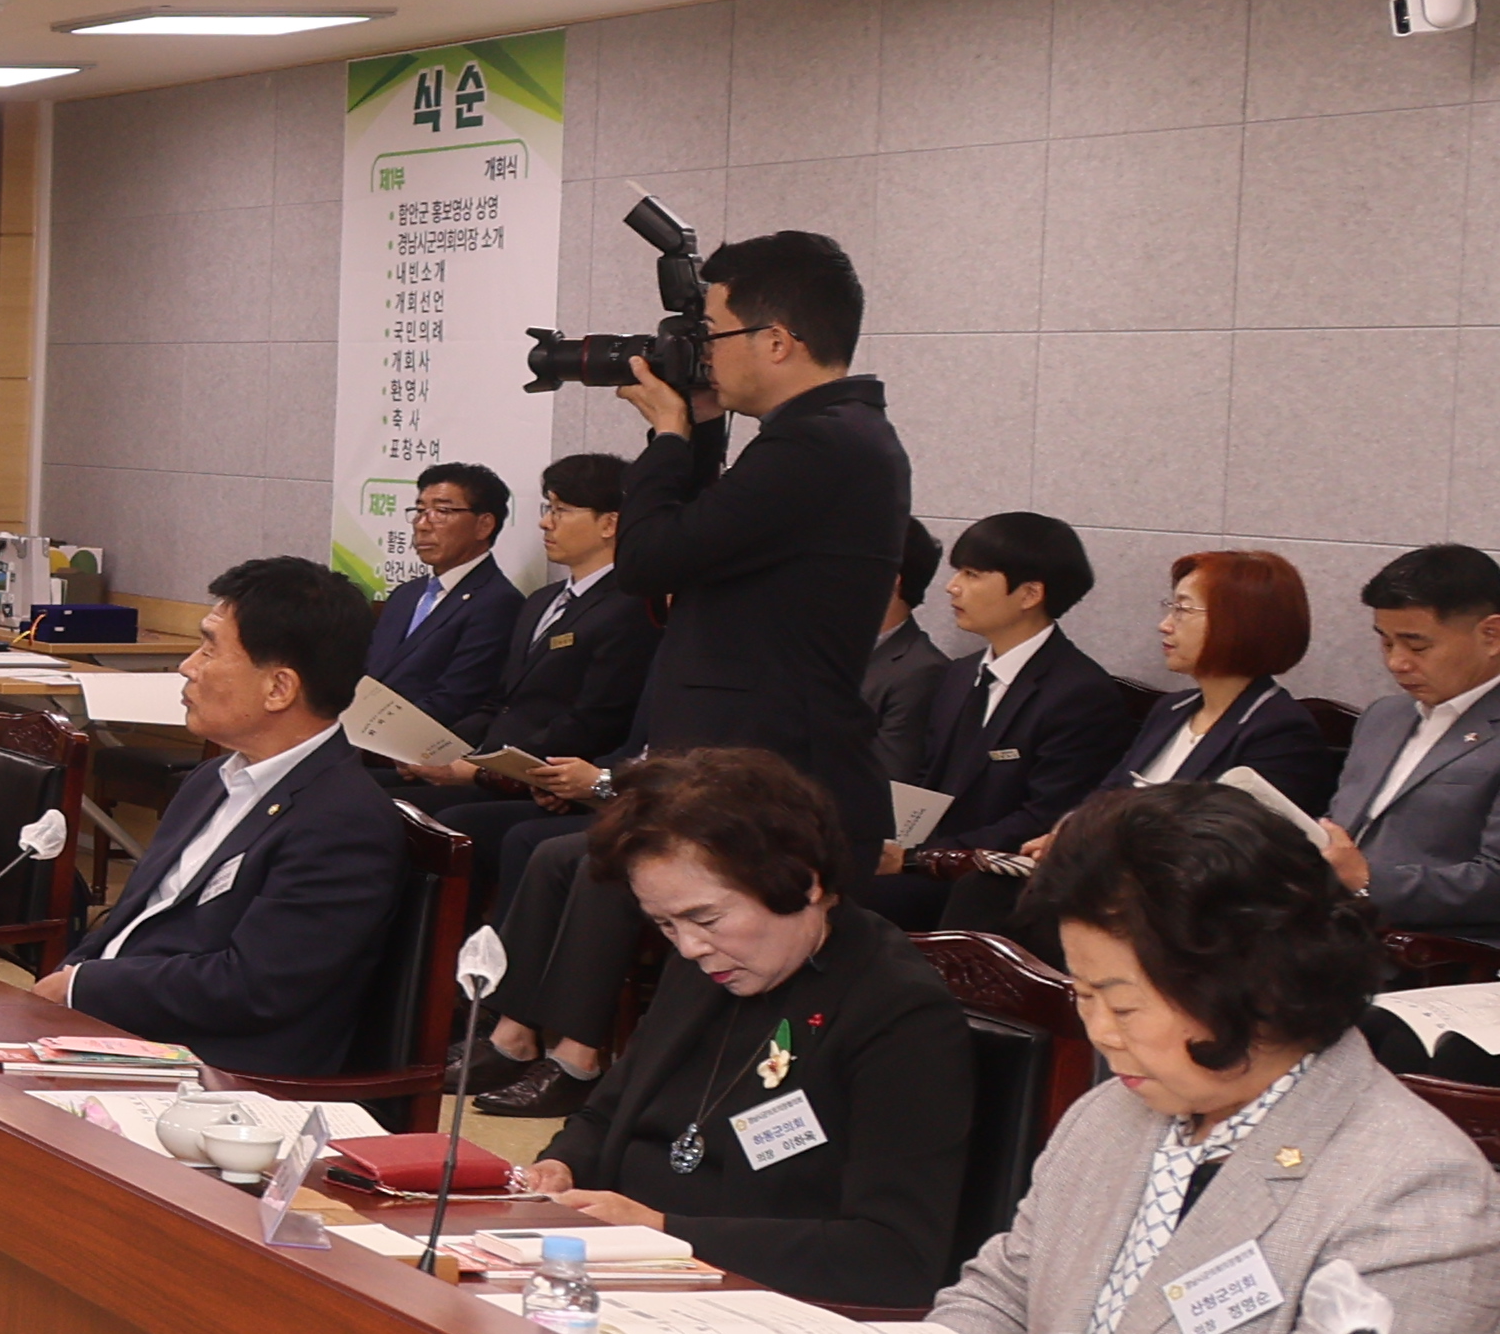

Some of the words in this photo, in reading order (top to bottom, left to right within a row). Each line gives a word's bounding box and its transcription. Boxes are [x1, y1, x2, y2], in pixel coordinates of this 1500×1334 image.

[413, 64, 487, 133] 식순
[483, 155, 518, 180] 개회식
[397, 200, 429, 225] 함안군
[431, 197, 473, 224] 홍보영상
[475, 195, 499, 221] 상영
[397, 228, 479, 255] 경남시군의회의장
[480, 225, 504, 250] 소개
[395, 259, 445, 284] 내빈소개
[393, 288, 445, 314] 개회선언
[392, 319, 444, 344] 국민의례
[390, 349, 430, 374] 개회사
[389, 378, 430, 403] 환영사
[389, 437, 441, 463] 표창수여
